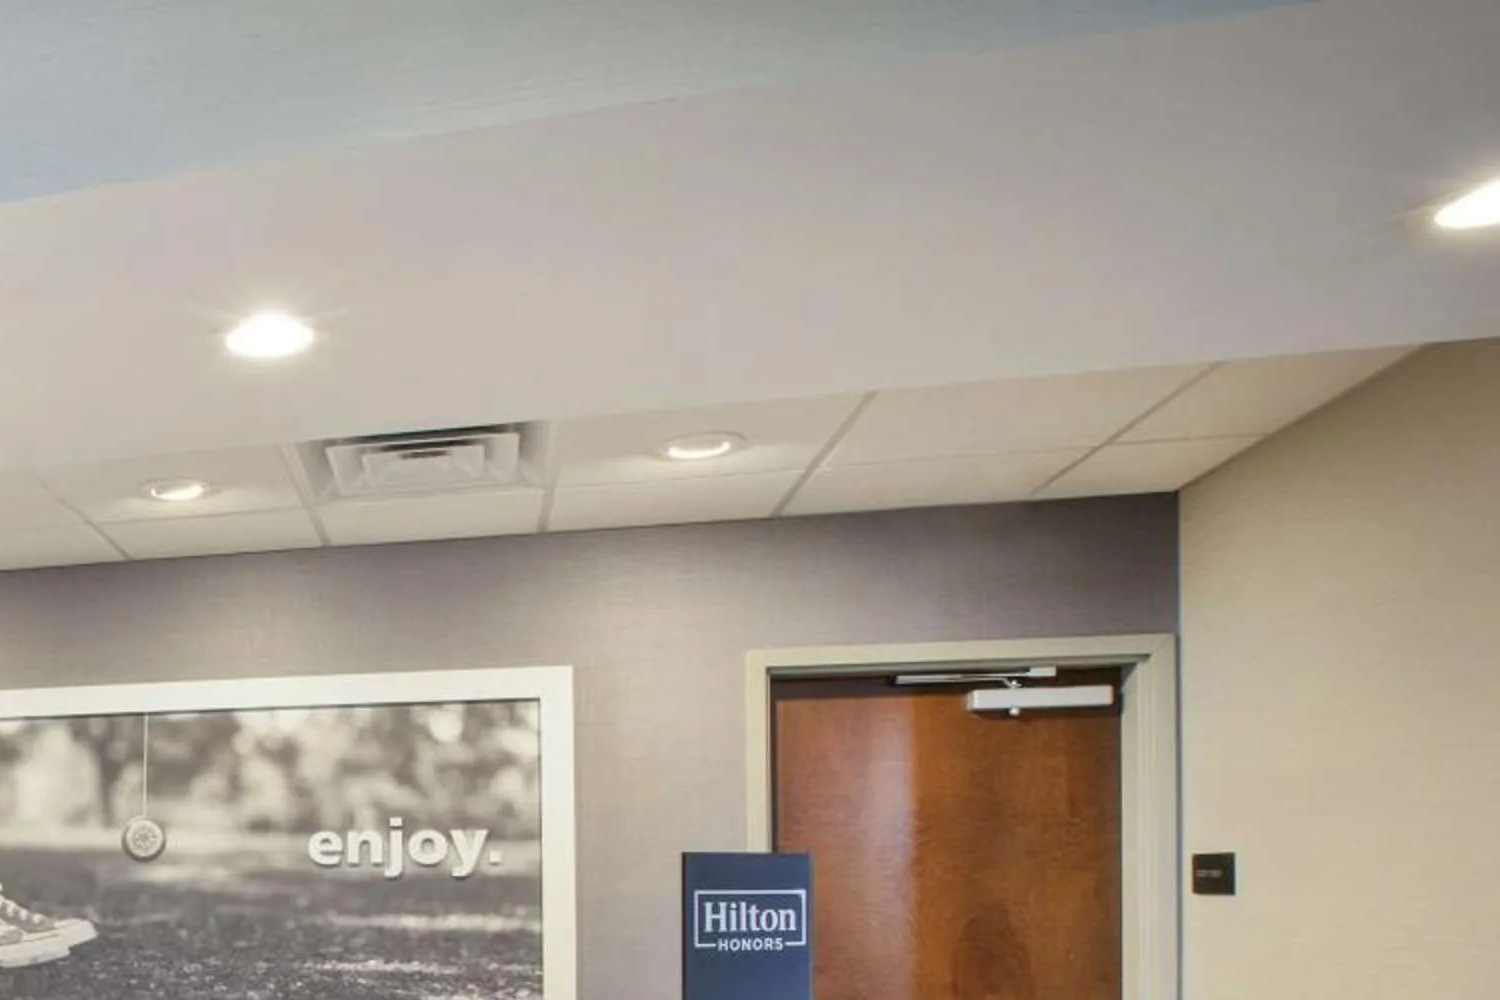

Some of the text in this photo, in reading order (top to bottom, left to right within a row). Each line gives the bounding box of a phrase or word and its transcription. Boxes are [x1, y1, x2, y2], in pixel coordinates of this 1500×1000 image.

[308, 817, 502, 878] enjoy.
[703, 901, 797, 933] Hilton
[717, 937, 784, 951] HONORS
